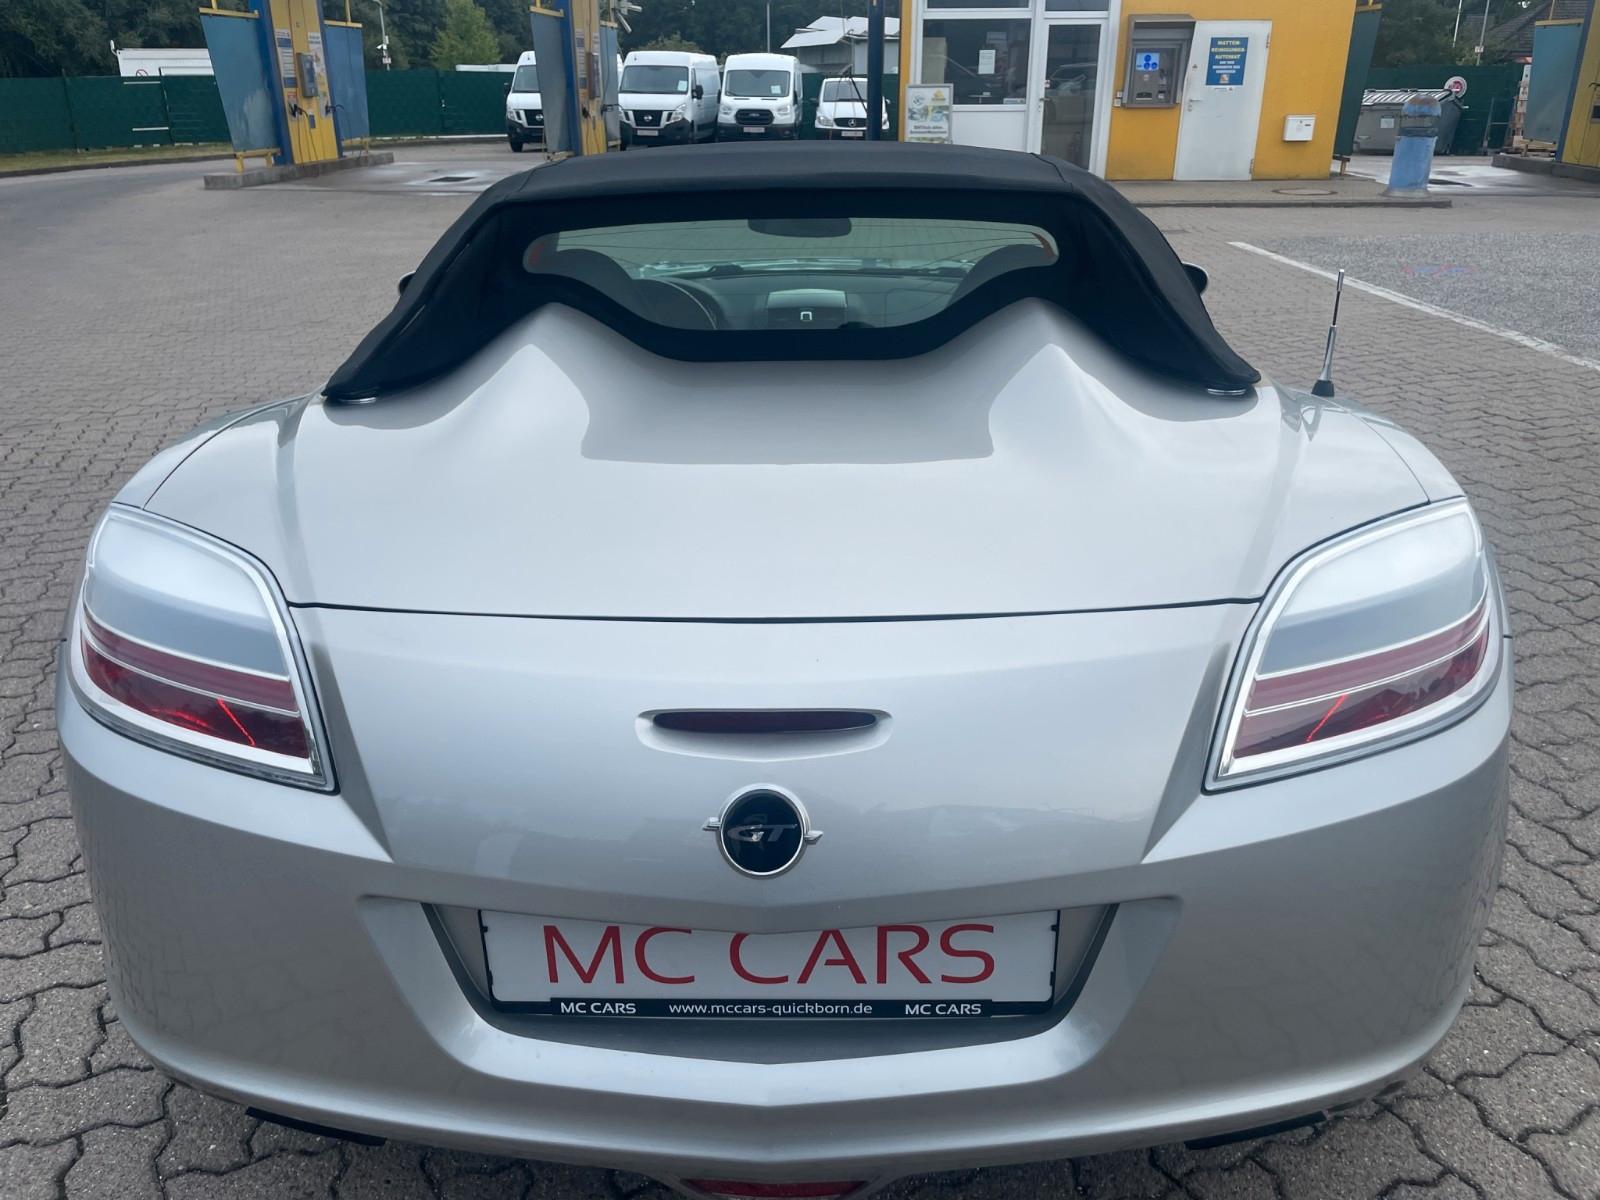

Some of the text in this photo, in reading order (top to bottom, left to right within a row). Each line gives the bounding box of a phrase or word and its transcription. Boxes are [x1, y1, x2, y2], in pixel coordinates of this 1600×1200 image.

[727, 824, 798, 842] GT
[543, 923, 995, 984] MC CARS
[560, 1002, 982, 1015] MC CARS www.mccars-quickborn.de MC CARS
